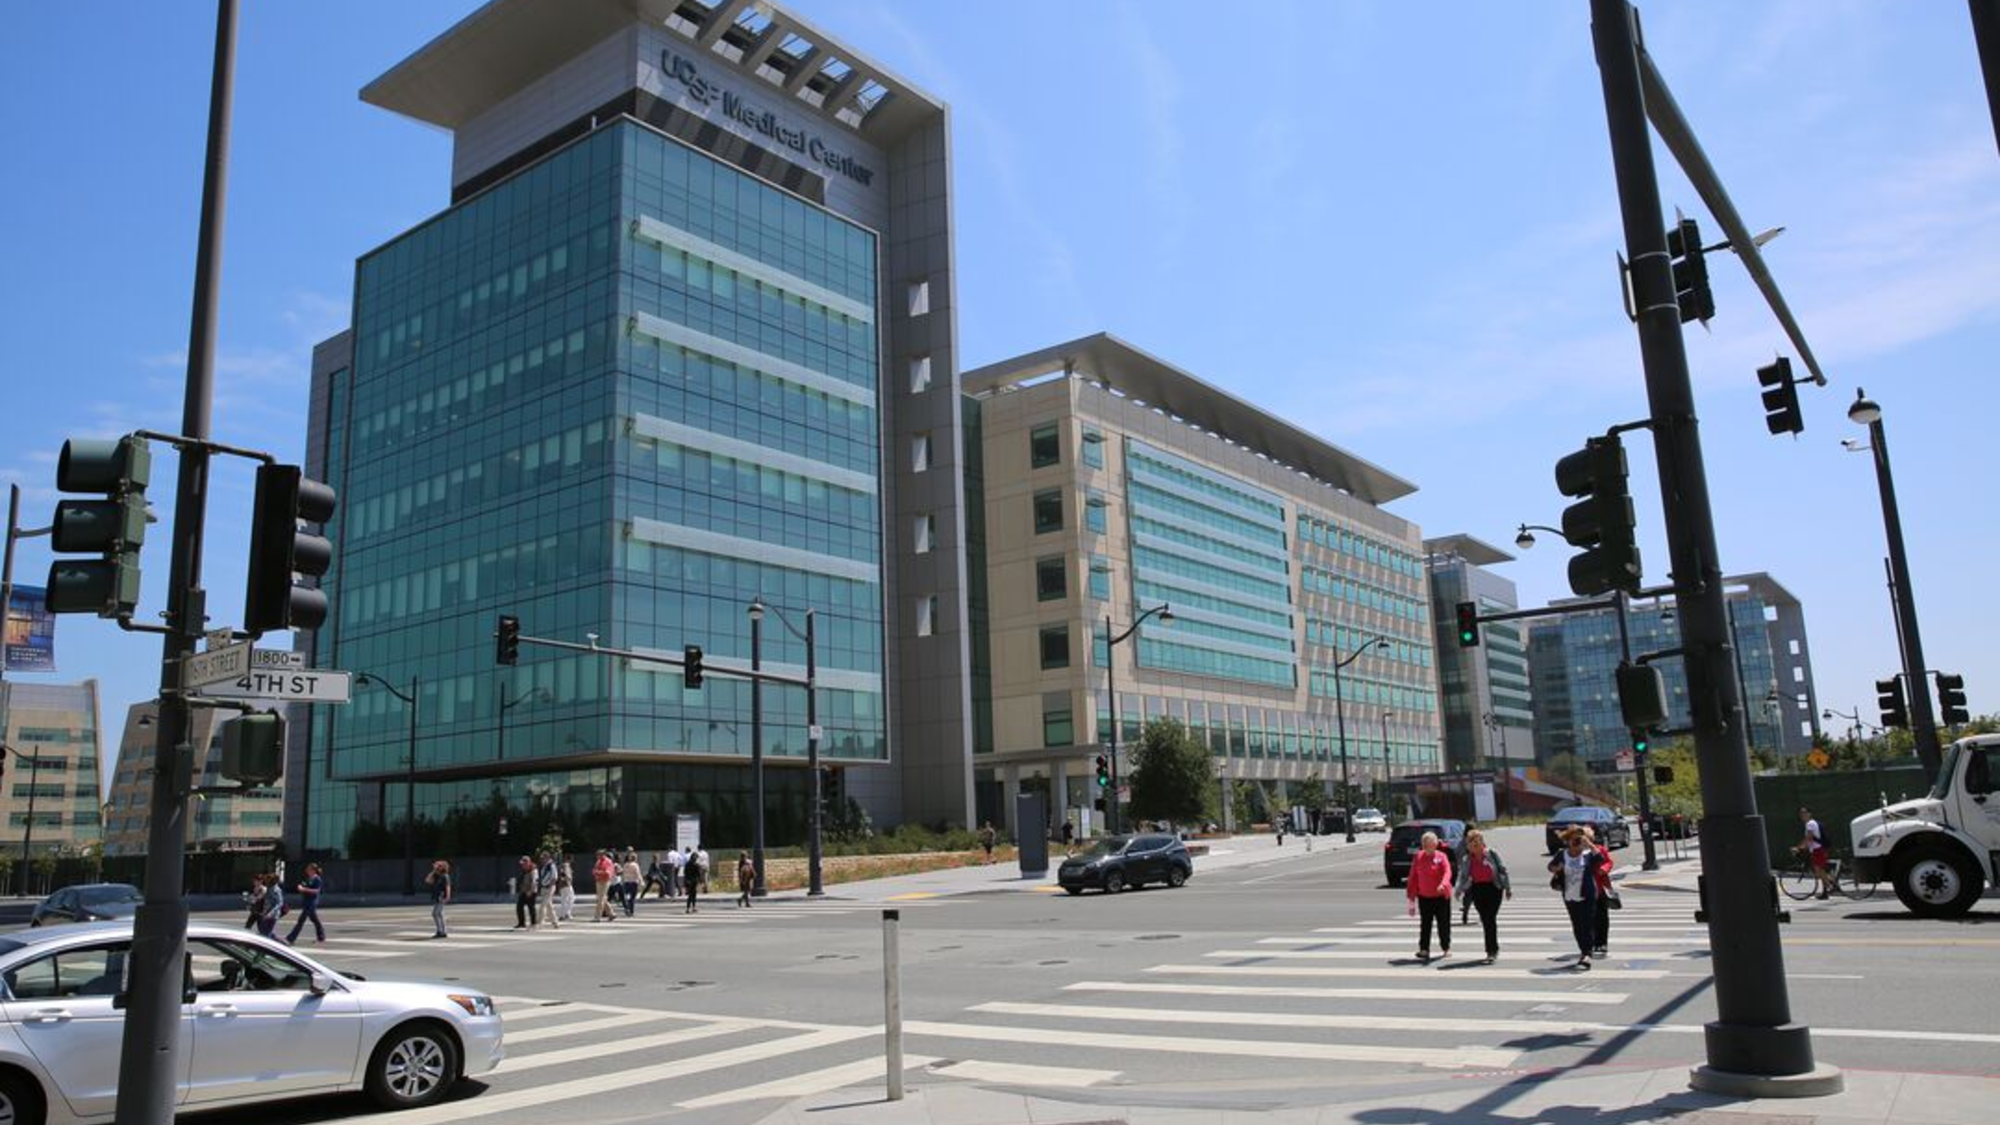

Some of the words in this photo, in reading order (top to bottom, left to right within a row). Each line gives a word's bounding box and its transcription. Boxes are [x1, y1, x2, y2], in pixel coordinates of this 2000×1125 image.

[661, 48, 720, 106] UCSF
[723, 90, 806, 153] Medical
[808, 137, 875, 187] Center
[236, 673, 284, 694] 4TH
[290, 675, 319, 695] ST
